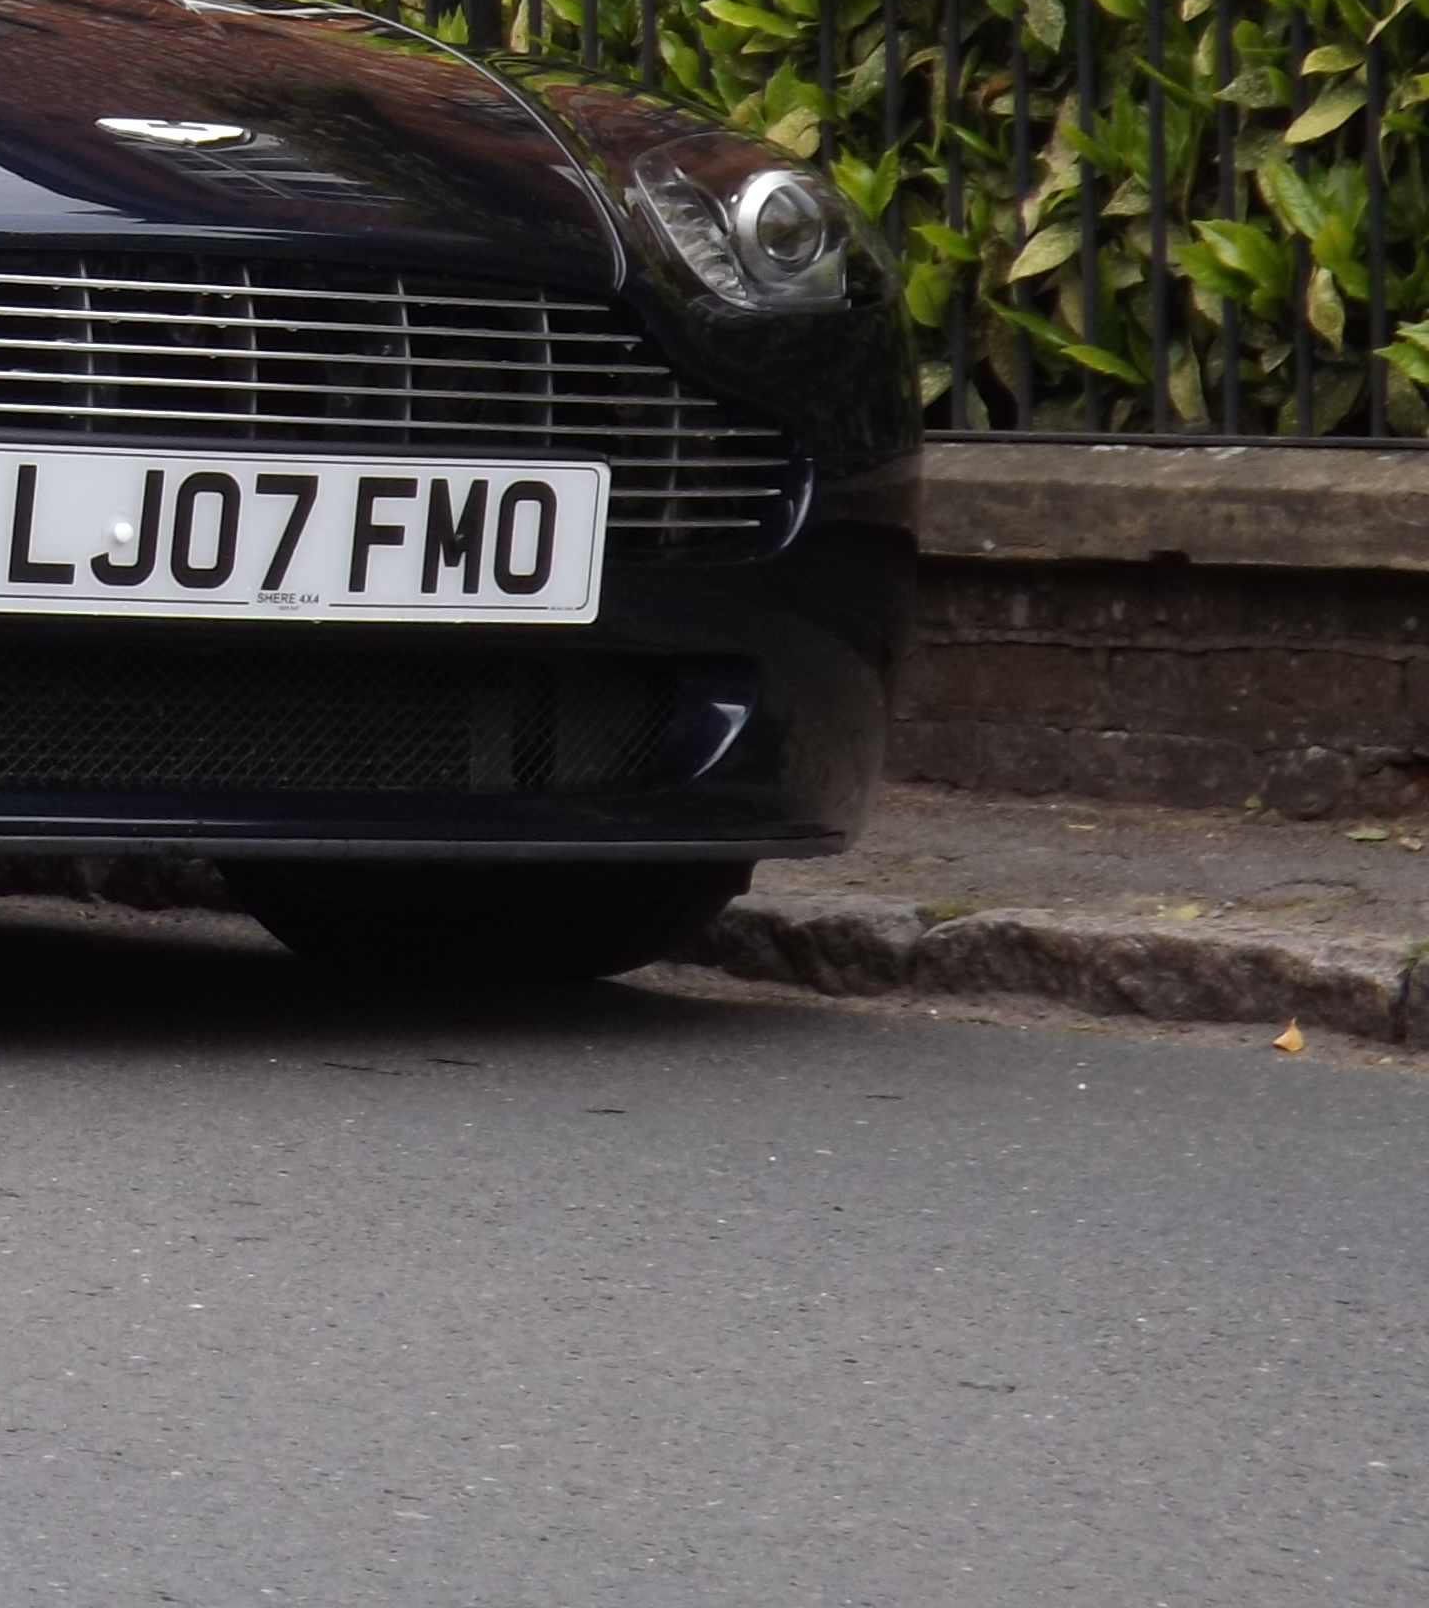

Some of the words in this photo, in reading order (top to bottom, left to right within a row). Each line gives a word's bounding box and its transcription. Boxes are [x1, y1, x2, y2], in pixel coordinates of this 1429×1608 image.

[7, 463, 320, 591] LJ07
[348, 475, 558, 595] FMO
[257, 592, 296, 604] SHERE
[299, 594, 319, 604] 4X4
